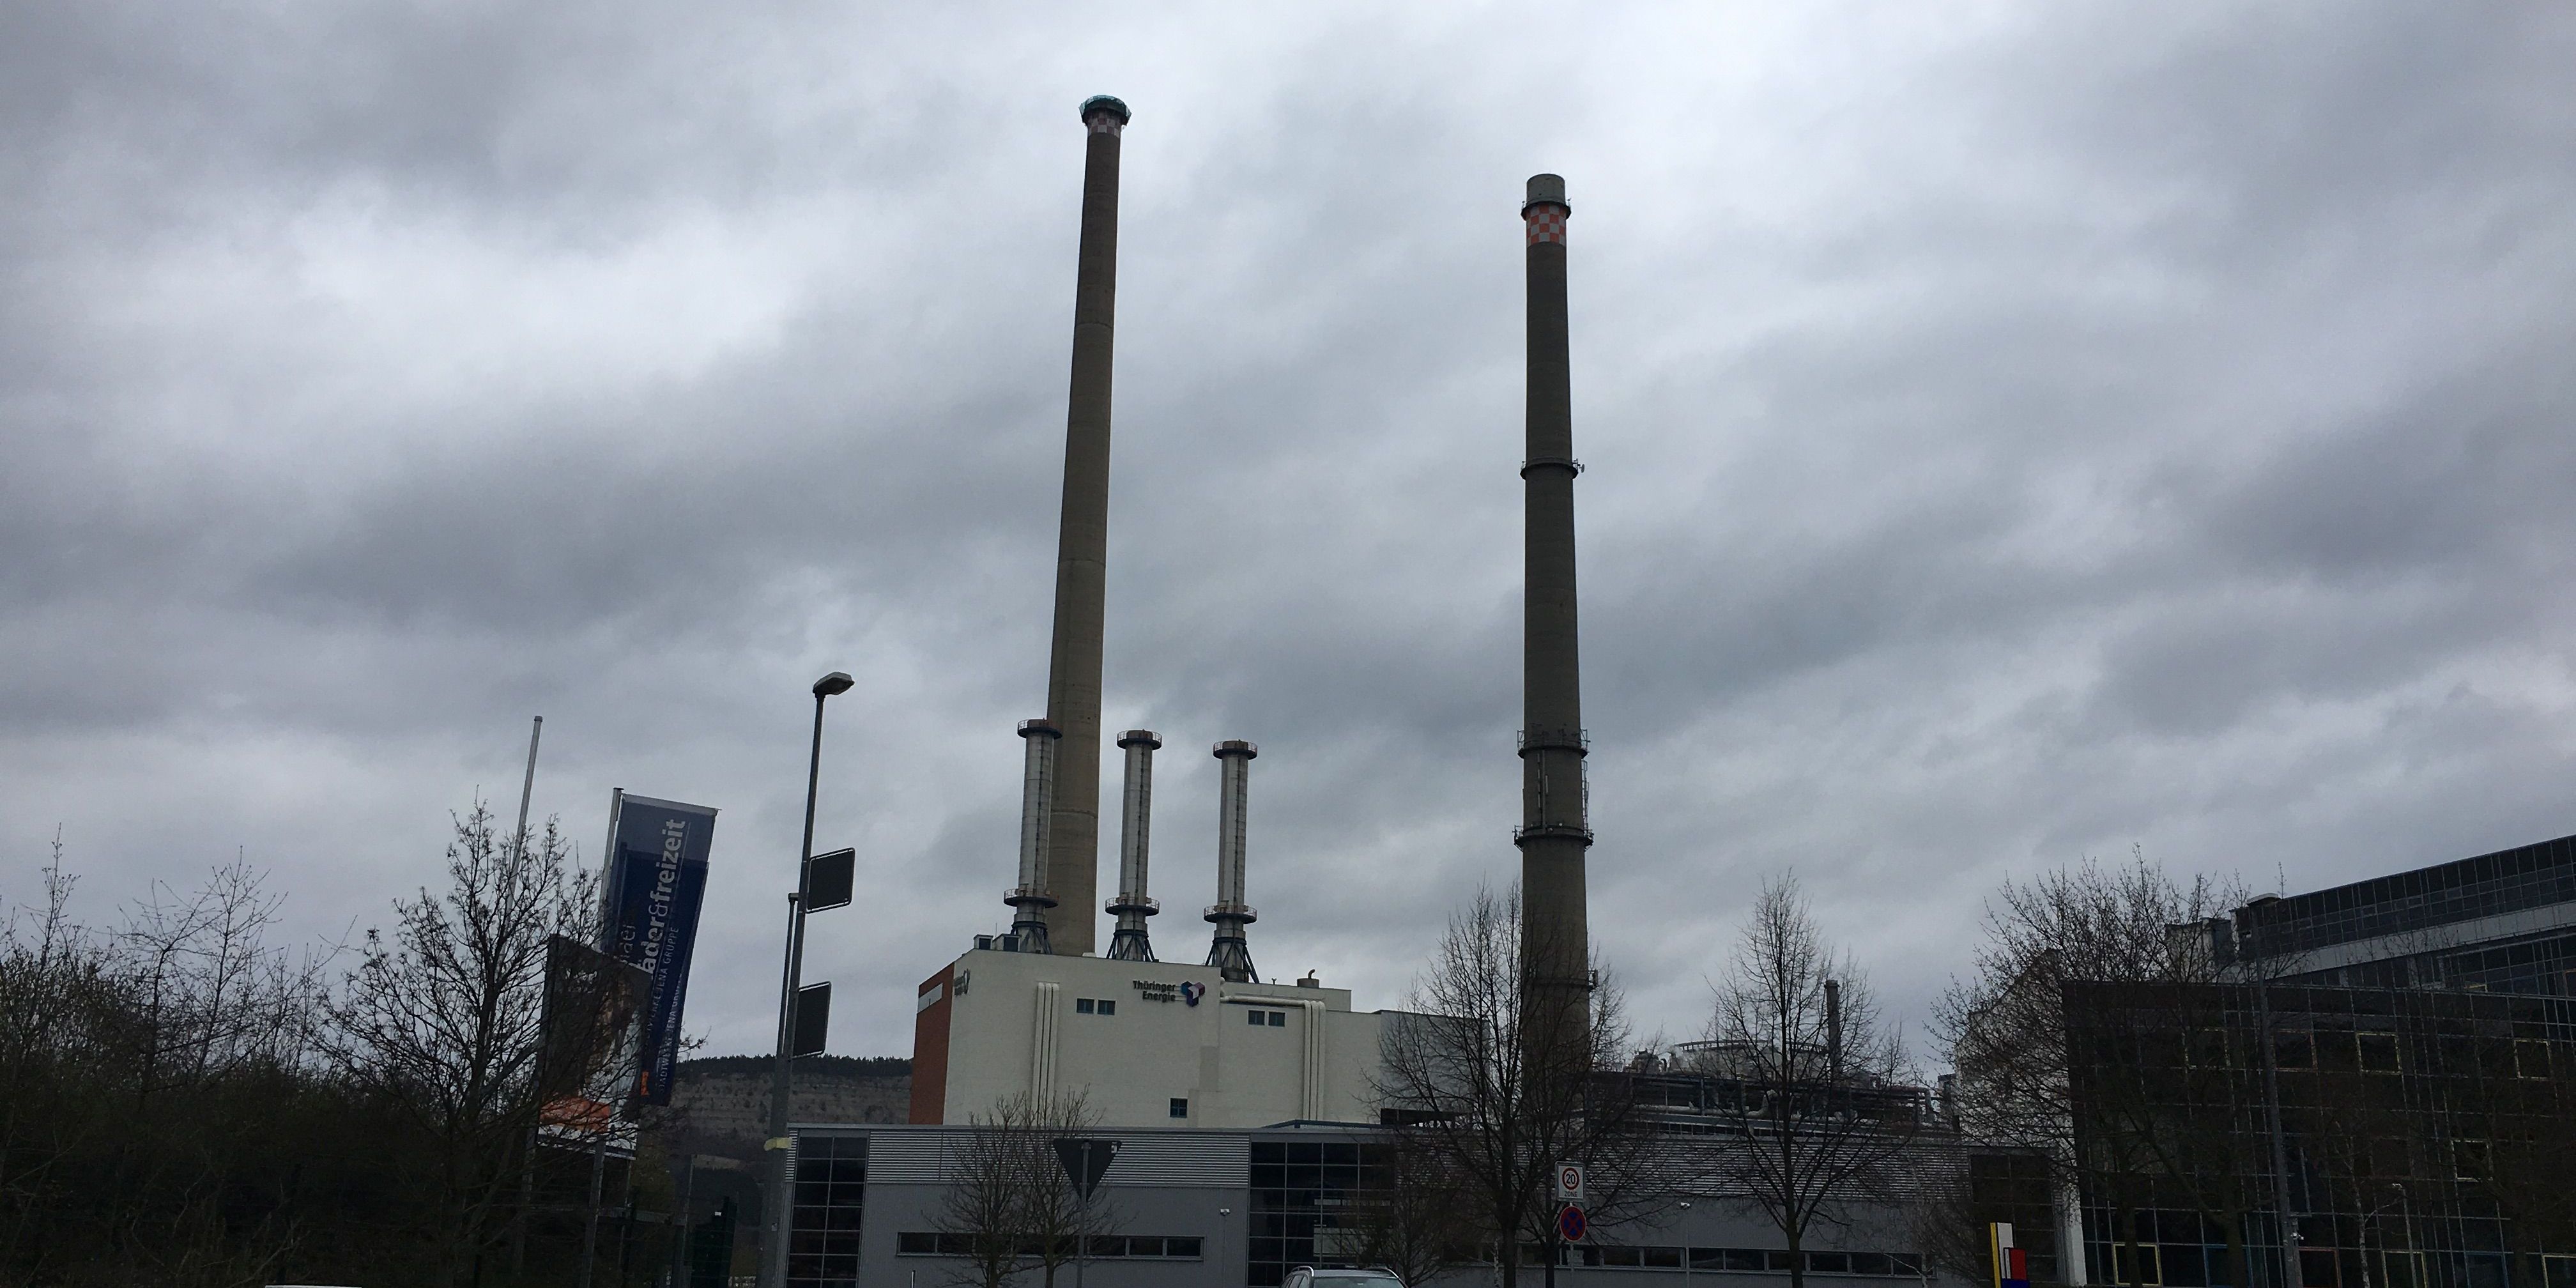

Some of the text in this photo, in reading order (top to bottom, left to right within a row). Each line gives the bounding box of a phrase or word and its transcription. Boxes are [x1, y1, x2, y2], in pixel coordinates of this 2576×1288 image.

[632, 818, 686, 979] äder&freizeit
[656, 968, 668, 992] JENA
[664, 926, 680, 964] GRUPPE
[1133, 980, 1176, 993] Thüringer
[1142, 990, 1176, 1003] Energie
[1566, 1174, 1576, 1184] 20
